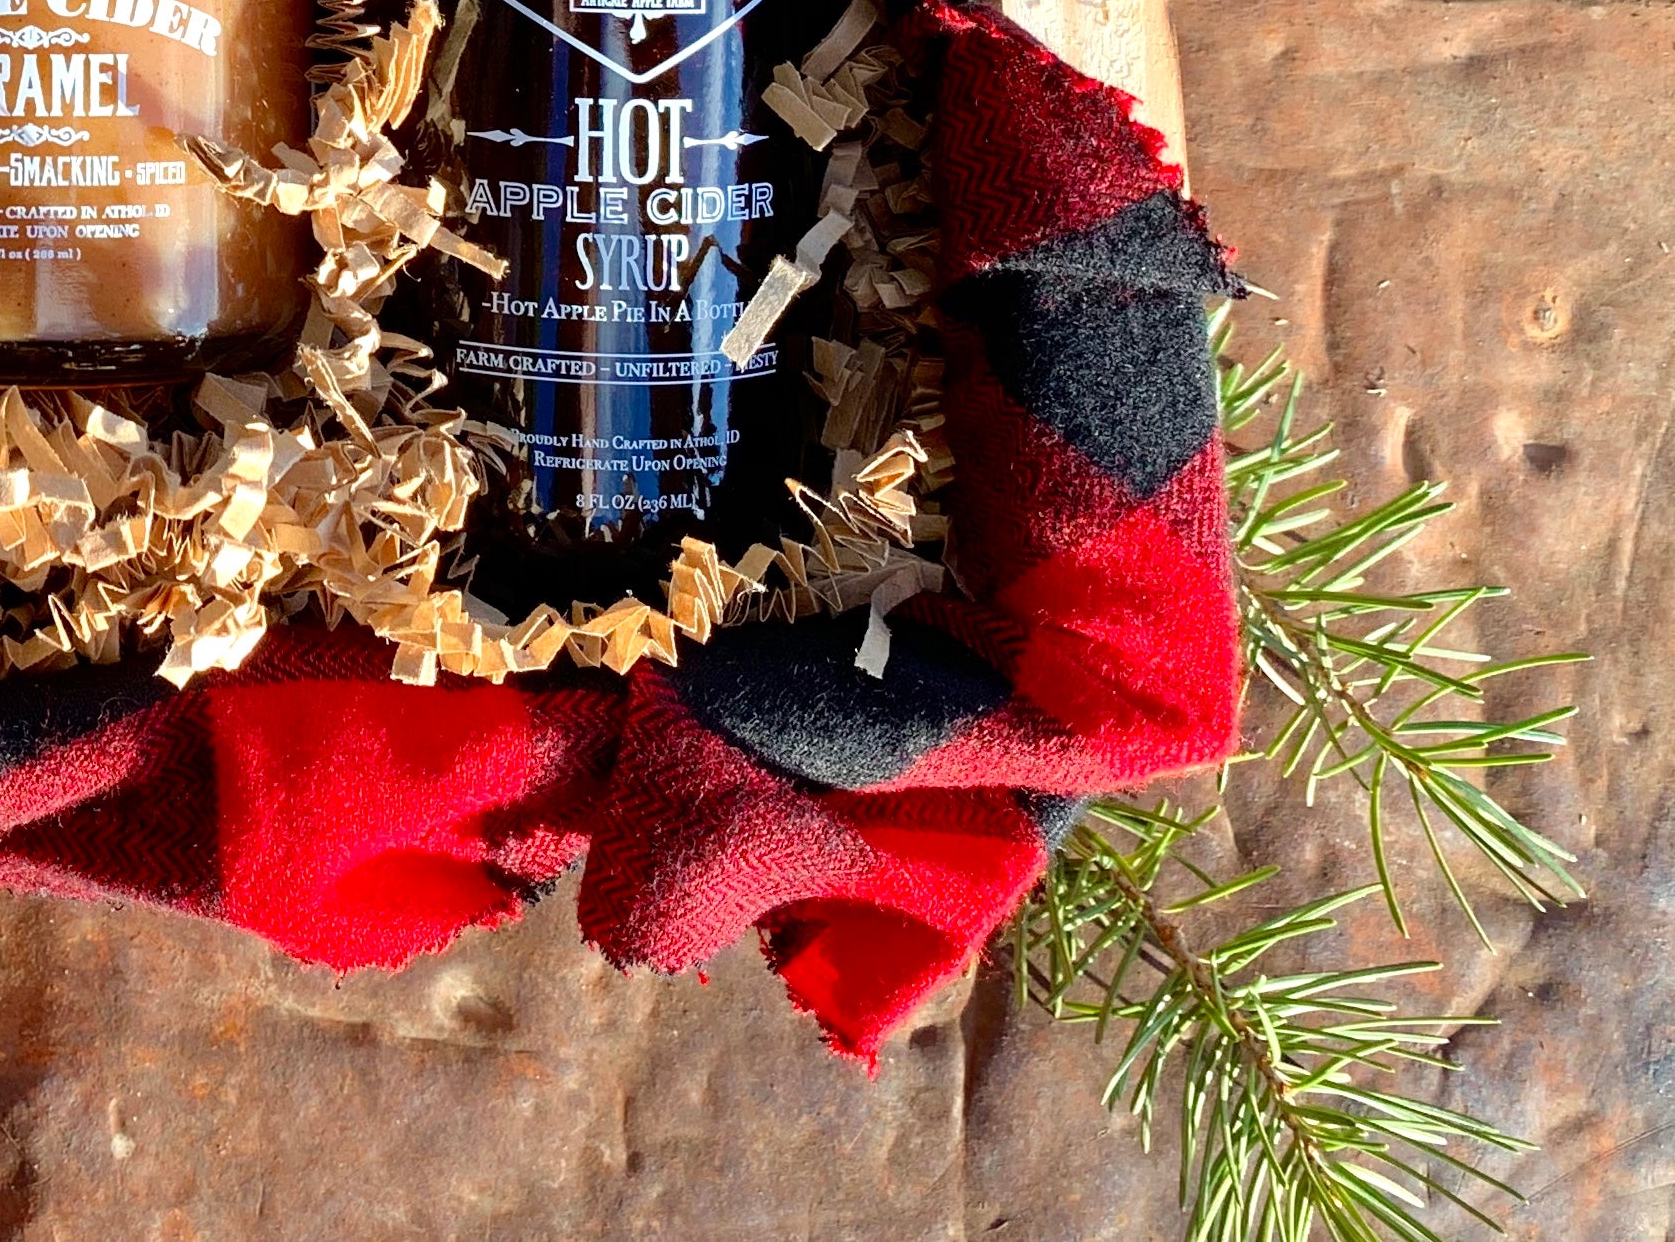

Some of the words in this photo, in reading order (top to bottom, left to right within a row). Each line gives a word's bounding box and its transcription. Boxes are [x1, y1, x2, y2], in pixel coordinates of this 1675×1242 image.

[574, 98, 693, 184] HOT
[136, 161, 185, 185] SPICED
[80, 205, 97, 219] IN
[465, 178, 628, 224] APPLE
[646, 183, 773, 224] CIDER
[26, 224, 69, 238] UPON
[75, 223, 140, 238] OPENING
[575, 233, 688, 291] SYRUP
[541, 297, 607, 321] APPLE
[611, 300, 645, 322] PIE
[649, 301, 671, 322] IN
[674, 300, 692, 322] A
[456, 348, 504, 369] FARM
[509, 355, 596, 376] CRAFTED
[615, 359, 721, 377] UNFILTERED
[571, 433, 609, 449] HAND
[612, 435, 667, 450] CRAFTED
[670, 438, 683, 449] IN
[726, 429, 741, 445] ID
[533, 450, 628, 471] REFRIGERATE
[631, 455, 670, 471] UPON
[673, 454, 727, 471] OPENING
[576, 493, 585, 508] 8
[589, 494, 609, 509] FL
[612, 494, 635, 510] OZ
[638, 495, 667, 513] (236
